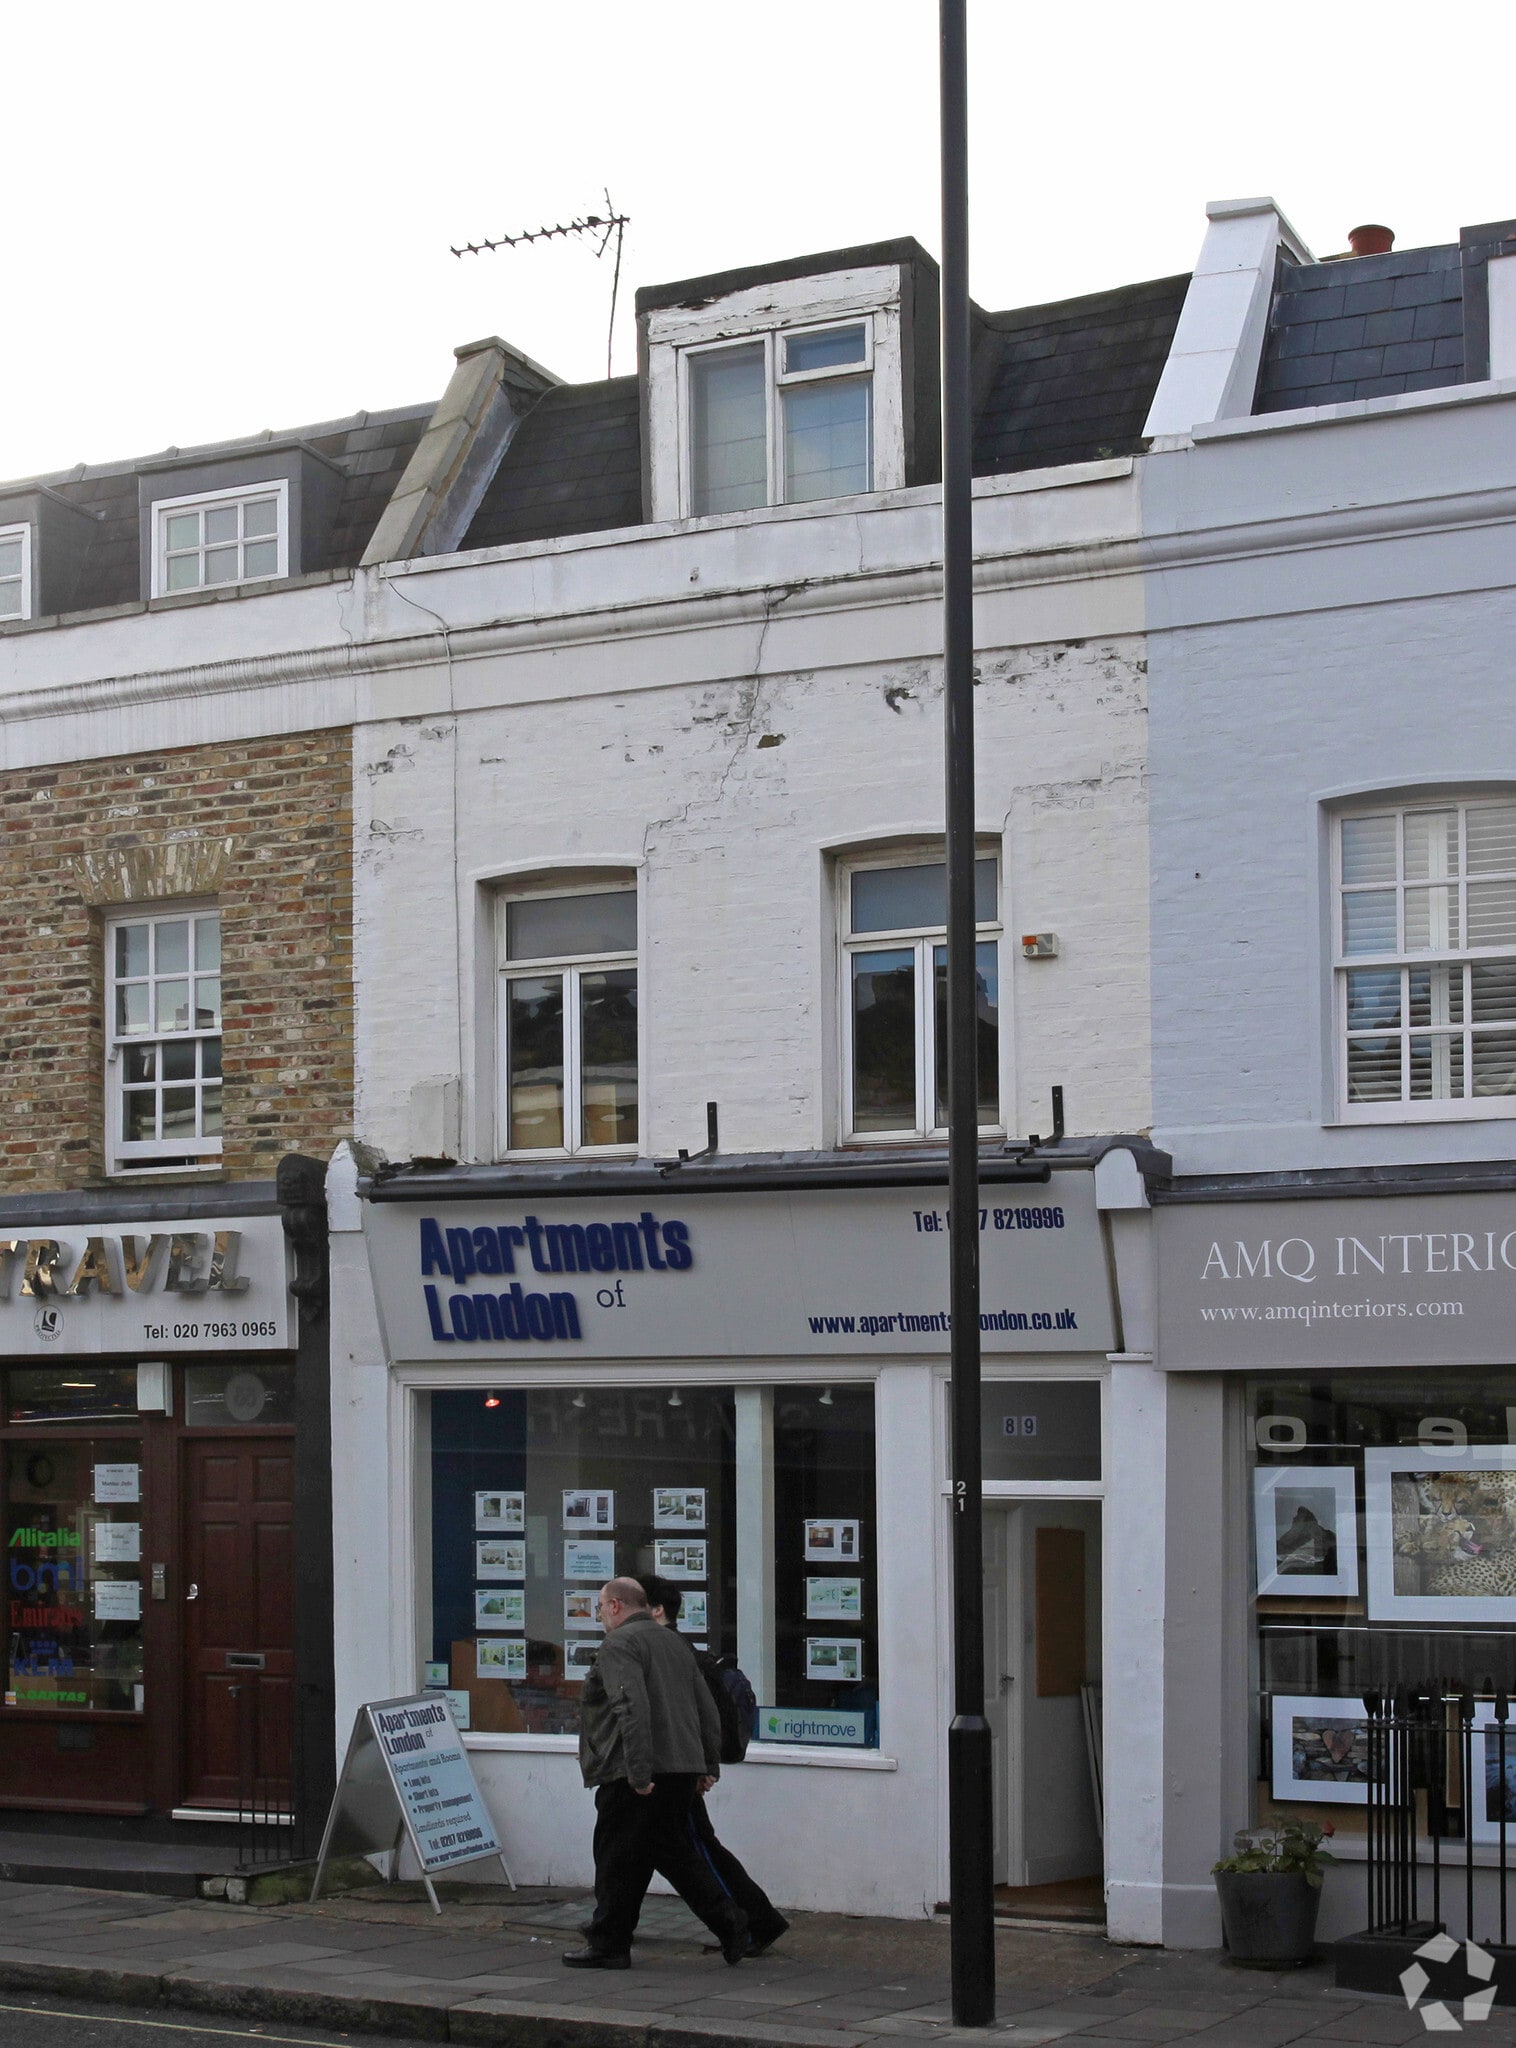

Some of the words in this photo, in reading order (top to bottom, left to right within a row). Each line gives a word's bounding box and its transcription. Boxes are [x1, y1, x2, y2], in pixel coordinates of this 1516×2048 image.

[913, 1210, 943, 1232] Tel:
[993, 1207, 1065, 1230] 8219996
[419, 1211, 694, 1284] Apartments
[1200, 1237, 1318, 1284] AMQ
[595, 1279, 627, 1308] of
[423, 1282, 583, 1341] London
[809, 1308, 1078, 1336] www.apartmentondon.co.uk
[1200, 1299, 1465, 1327] www.amqinteriors.com
[144, 1325, 169, 1339] Tel:
[173, 1323, 199, 1338] 020
[203, 1322, 237, 1338] 7963
[241, 1321, 277, 1337] 0965
[8, 1528, 81, 1547] Alitalia
[11, 1557, 84, 1591] bmi
[11, 1602, 83, 1627] Emirates
[13, 1658, 75, 1678] KLM
[27, 1690, 87, 1703] QANTAS
[378, 1704, 446, 1735] Apartments
[784, 1719, 857, 1738] rightmove
[383, 1732, 426, 1756] London
[426, 1728, 434, 1738] of
[429, 1758, 442, 1766] and
